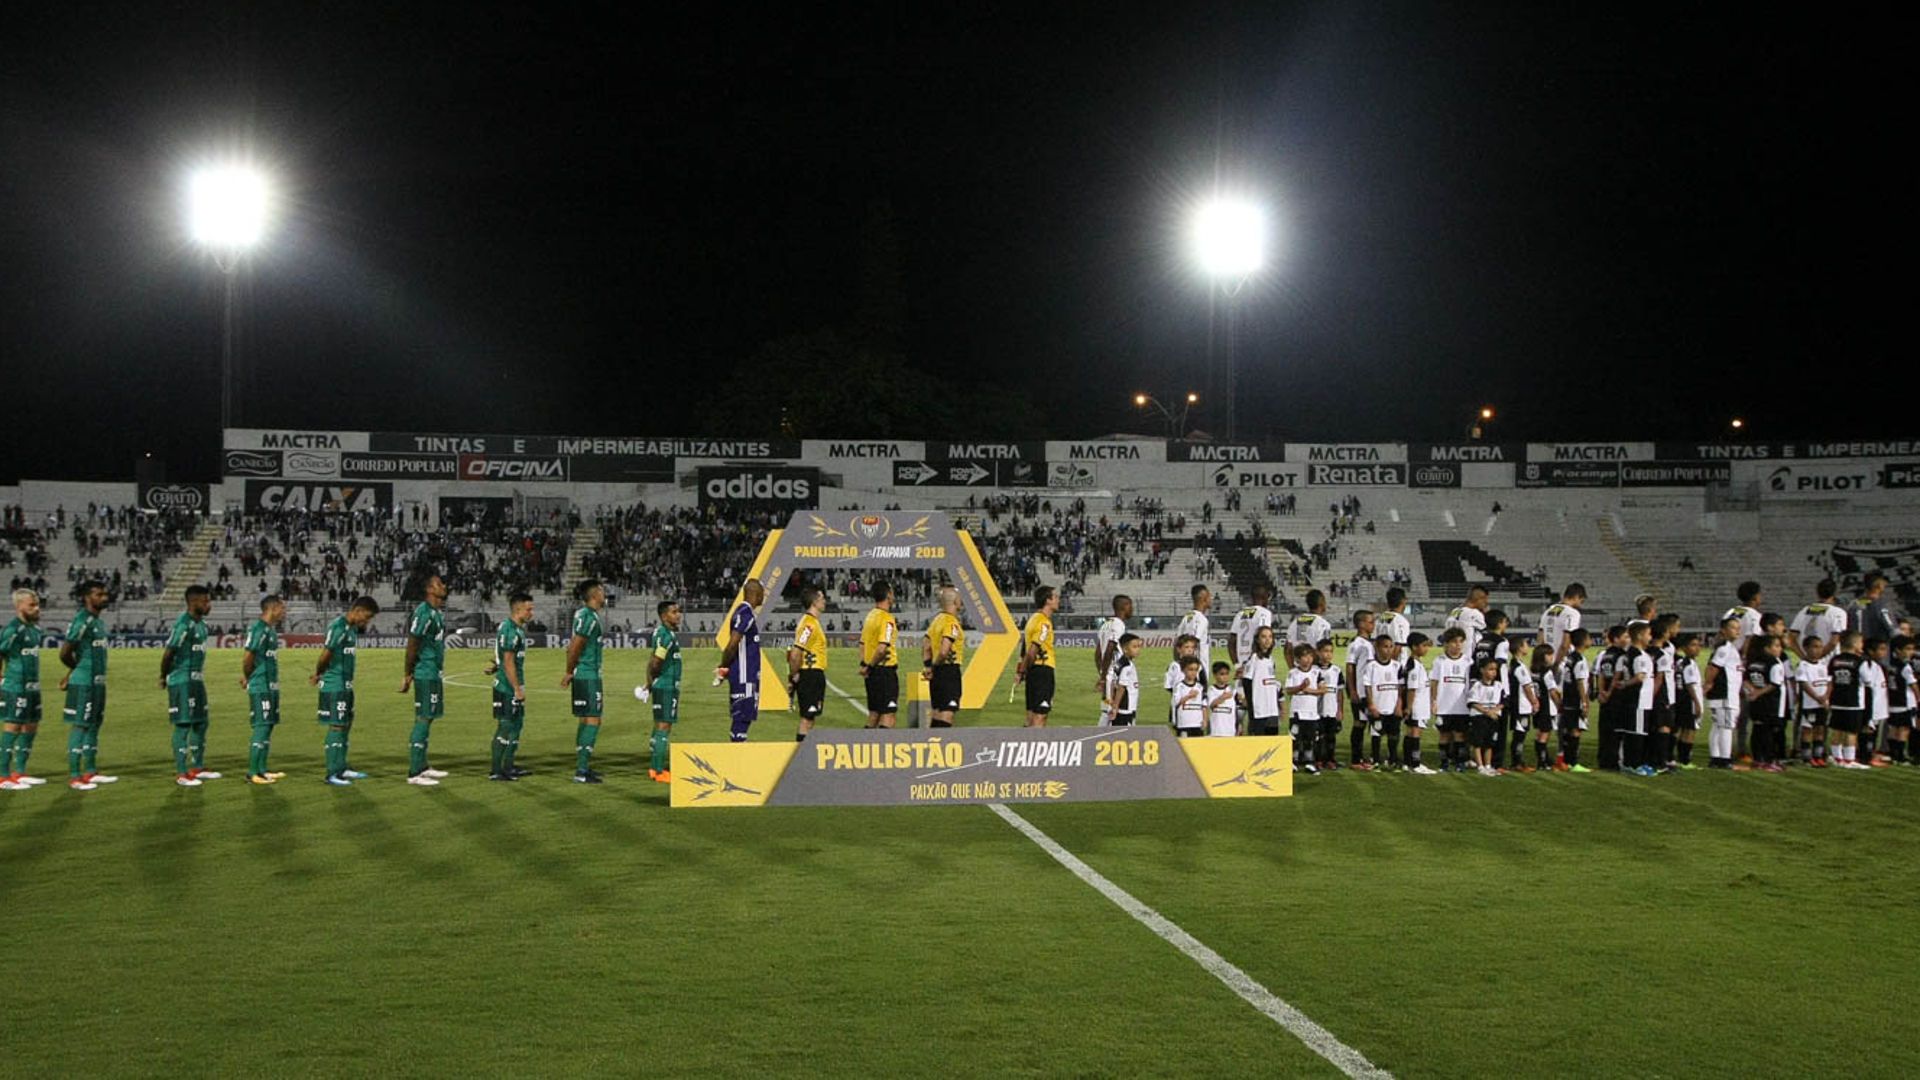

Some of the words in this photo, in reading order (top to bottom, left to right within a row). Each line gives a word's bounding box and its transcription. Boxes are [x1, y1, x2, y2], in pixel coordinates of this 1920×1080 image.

[262, 435, 342, 449] MACTRA
[414, 438, 485, 453] TINTAS
[514, 440, 526, 453] E
[558, 441, 770, 457] IMPERMEABILIZANTES
[829, 444, 899, 458] MACTRA
[949, 445, 1020, 460] MACTRA
[1070, 446, 1139, 460] MACTRA
[1190, 446, 1260, 461] MACTRA
[1308, 447, 1379, 461] MACTRA
[1431, 446, 1503, 461] MACTRA
[1555, 447, 1627, 460] MACTRA
[1697, 446, 1769, 459] TINTAS
[1783, 445, 1795, 458] E
[343, 460, 398, 473] CORREIO
[400, 460, 455, 474] POPULAR
[467, 460, 564, 478] OFICINA
[1313, 464, 1398, 485] Renata
[706, 473, 809, 499] adidas
[1240, 473, 1298, 487] PILOT
[1798, 476, 1866, 490] PILOT
[260, 486, 376, 512] CAIXA
[795, 543, 858, 558] PAULISTÃO
[872, 546, 910, 558] ITAIPAVA
[916, 547, 945, 558] 2018
[816, 737, 964, 769] PAULISTÃO
[997, 740, 1083, 767] ITAIPAVA
[1094, 740, 1160, 766] 2018
[910, 782, 947, 800] PAIXÃO
[951, 782, 970, 799] QUE
[974, 782, 996, 799] NÃO
[999, 783, 1015, 799] SE
[1018, 783, 1045, 798] MEDE
